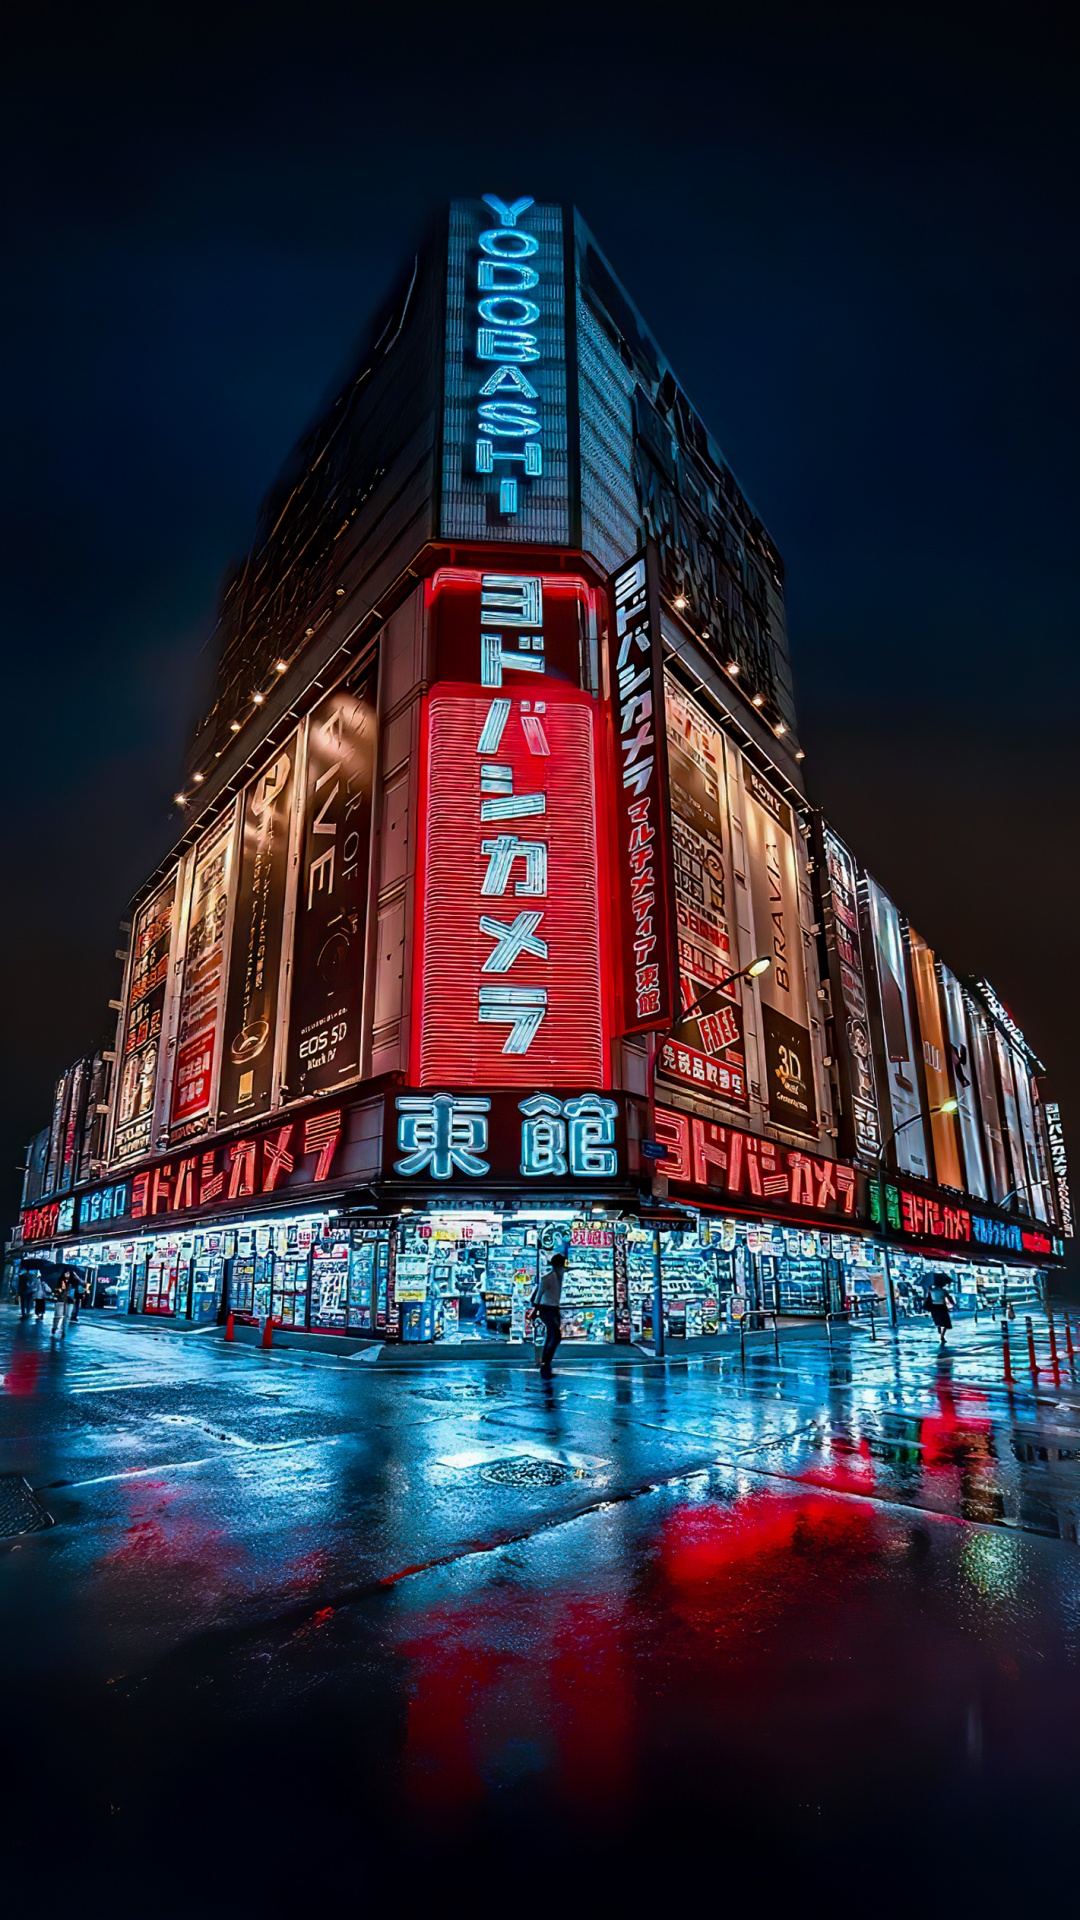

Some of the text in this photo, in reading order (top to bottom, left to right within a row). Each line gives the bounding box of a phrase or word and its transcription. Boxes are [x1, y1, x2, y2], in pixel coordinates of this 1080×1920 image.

[475, 193, 543, 514] YODOBASHI
[615, 558, 655, 796] ヨドバシカメラ
[475, 574, 550, 1056] ヨドバシカメラ
[299, 1022, 347, 1059] EOS 5D
[699, 1006, 741, 1055] FREE
[778, 1044, 802, 1080] 3D
[131, 1109, 342, 1219] ヨドバシカメラ
[393, 1091, 619, 1180] 東館
[655, 1107, 855, 1214] ヨドバシカメラ
